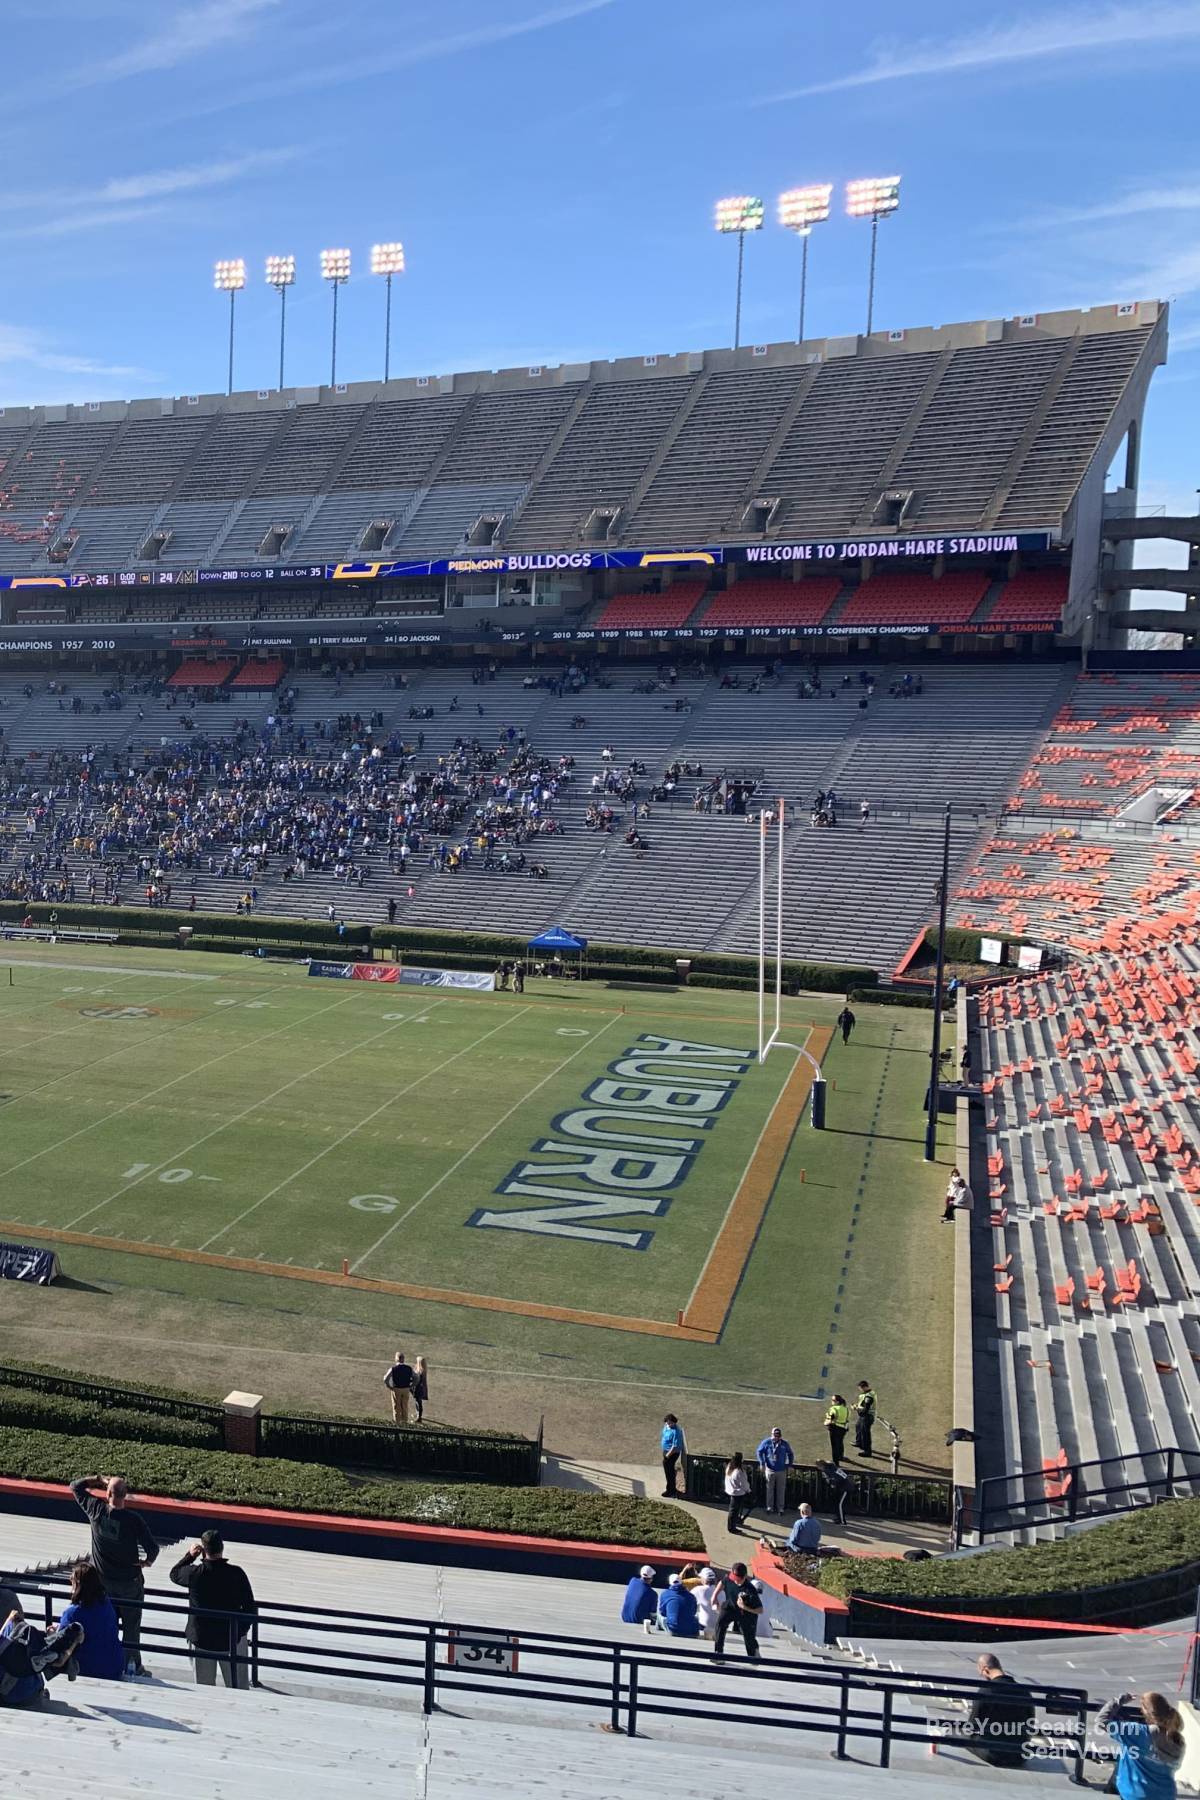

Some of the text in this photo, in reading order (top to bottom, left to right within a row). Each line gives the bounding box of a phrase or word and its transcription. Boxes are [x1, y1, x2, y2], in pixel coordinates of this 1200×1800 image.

[747, 536, 1018, 562] WELCOME TO JORDAN-HARE STADIUM
[448, 553, 592, 571] PIEDMONT BULLDOGS
[160, 572, 173, 583] 24
[201, 571, 221, 580] DOWN
[223, 570, 238, 580] 2ND
[240, 571, 249, 579] TO
[251, 571, 261, 579] GO
[265, 569, 274, 578] 12
[295, 569, 307, 577] ON
[310, 567, 321, 577] 35
[96, 575, 109, 585] 26
[502, 633, 520, 641] 2013
[625, 630, 643, 638] 1988
[650, 629, 668, 637] 1987
[700, 628, 718, 637] 1957
[725, 628, 744, 637] 1932
[751, 628, 770, 636] 1919
[777, 627, 796, 636] 1914
[803, 627, 823, 635] 1913
[826, 626, 877, 636] CONFERENCE
[879, 625, 930, 635] CHAMPIONS
[938, 622, 1054, 634] JORDAN HARE STADIUM
[0, 641, 53, 650] CHAMPIONS
[62, 640, 83, 650] 1957
[92, 640, 115, 649] 2010
[410, 635, 441, 643] JACKSON
[464, 1033, 757, 1250] AUBURN
[121, 1163, 194, 1184] 10
[349, 1194, 400, 1215] G
[464, 1645, 505, 1664] 34
